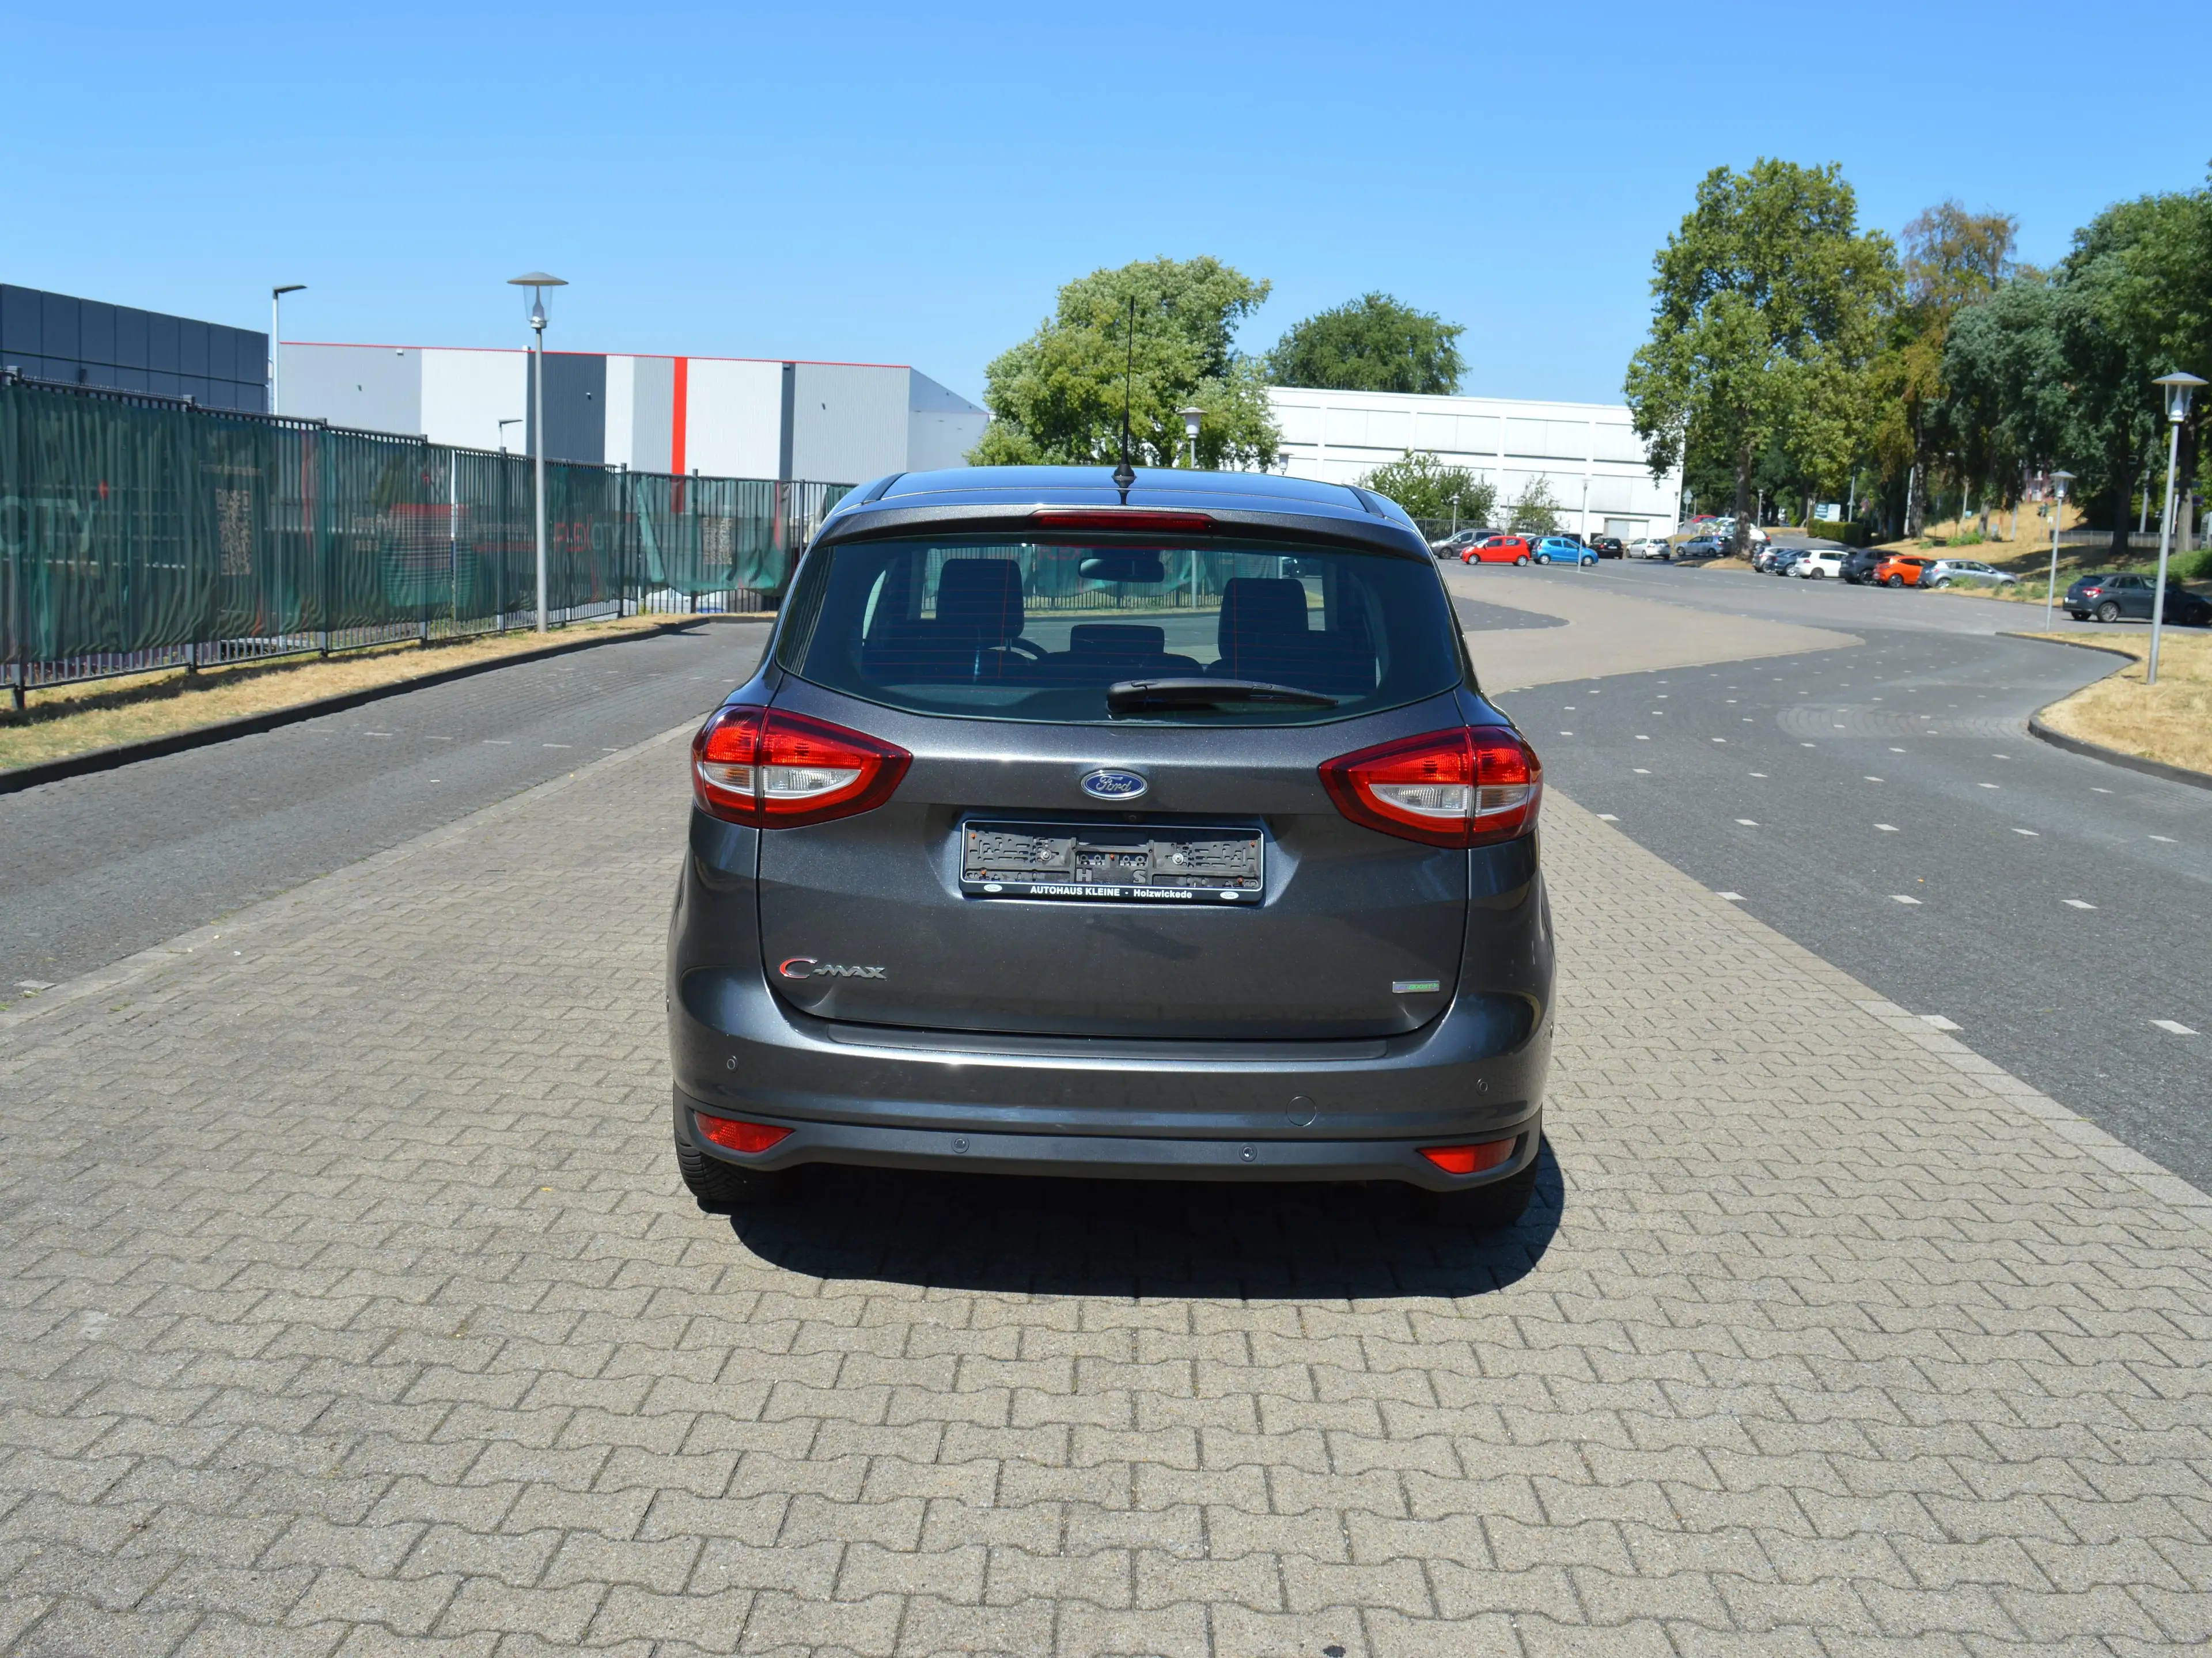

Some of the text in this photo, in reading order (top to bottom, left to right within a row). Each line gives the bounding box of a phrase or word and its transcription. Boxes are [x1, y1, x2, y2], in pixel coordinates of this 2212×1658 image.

[1096, 775, 1132, 792] Ford
[1030, 886, 1083, 896] AUTOHAUS
[1085, 887, 1120, 897] KLEINE
[1133, 889, 1192, 898] Holzwickede
